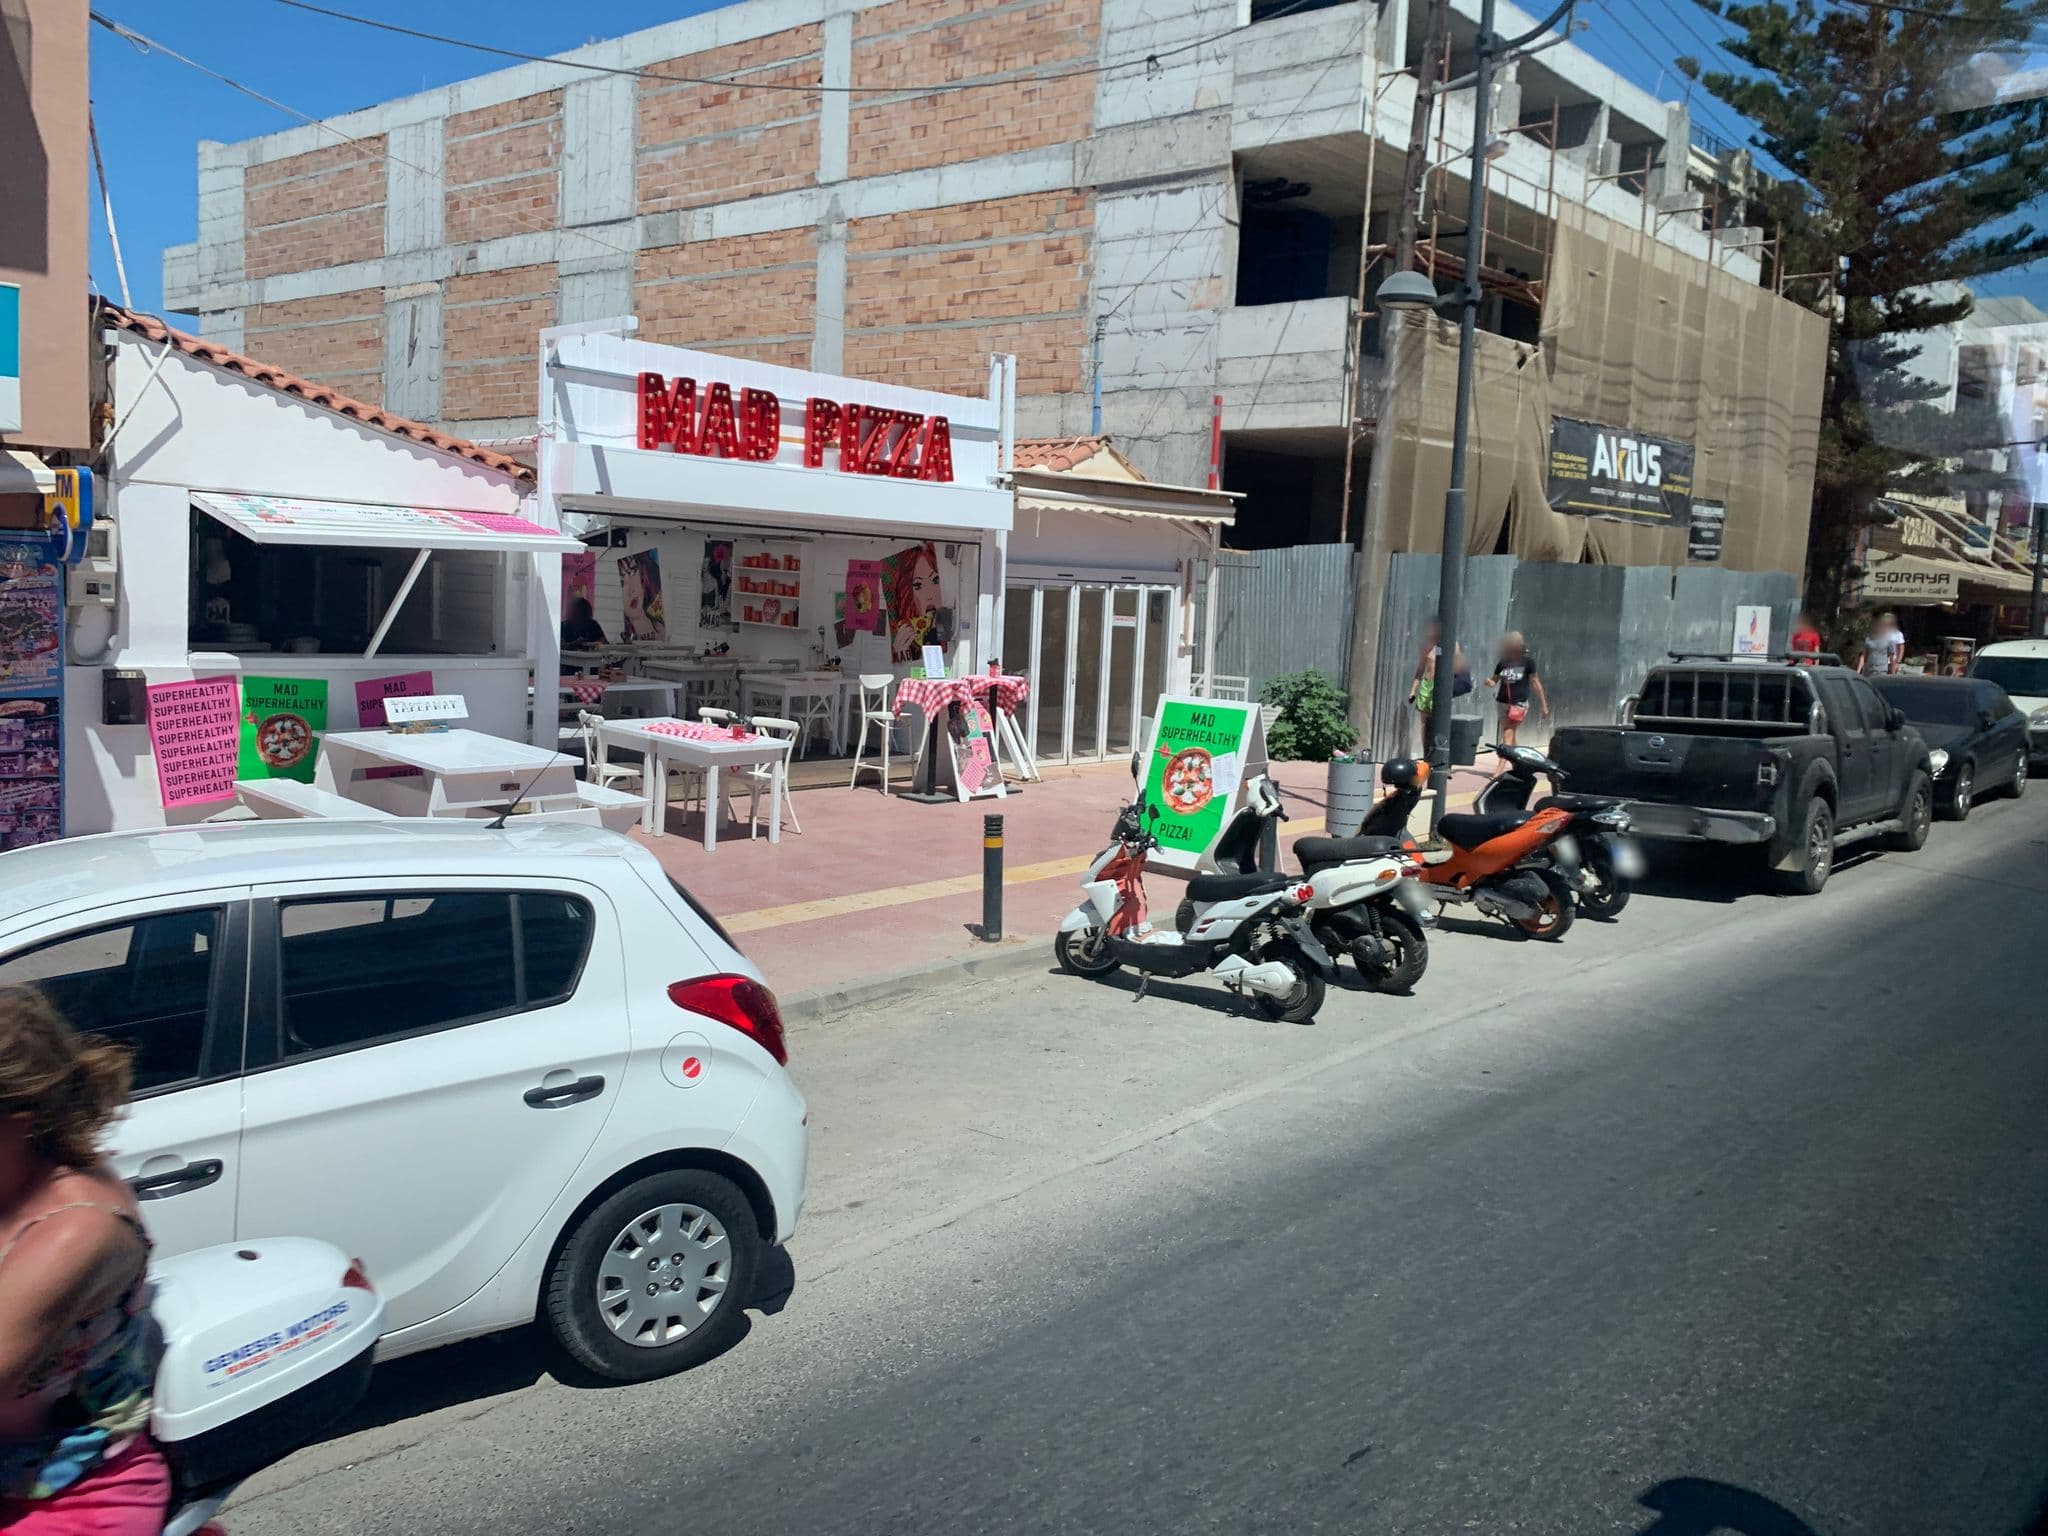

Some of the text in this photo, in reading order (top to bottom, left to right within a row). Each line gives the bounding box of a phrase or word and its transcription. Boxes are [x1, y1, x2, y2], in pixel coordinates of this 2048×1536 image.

[637, 371, 954, 482] MAD PIZZA
[47, 474, 73, 498] TM
[1875, 571, 1950, 584] SORAYA
[1874, 585, 1922, 594] restaurant
[152, 684, 230, 703] SUPERHEALTHY
[273, 683, 299, 696] MAD
[383, 681, 407, 695] MAD
[154, 698, 231, 717] SUPERHEALTHY
[245, 697, 325, 711] SUPERHEALTHY
[156, 711, 233, 731] SUPERHEALTHY
[1190, 712, 1216, 727] MAD
[158, 725, 234, 745] SUPERHEALTHY
[1161, 726, 1238, 747] SUPERHEALTHY
[160, 738, 236, 759] SUPERHEALTHY
[163, 751, 238, 773] SUPERHEALTHY
[1158, 823, 1194, 841] PIZZA!
[202, 1331, 283, 1374] GENESIS
[285, 1300, 351, 1338] MOTORS
